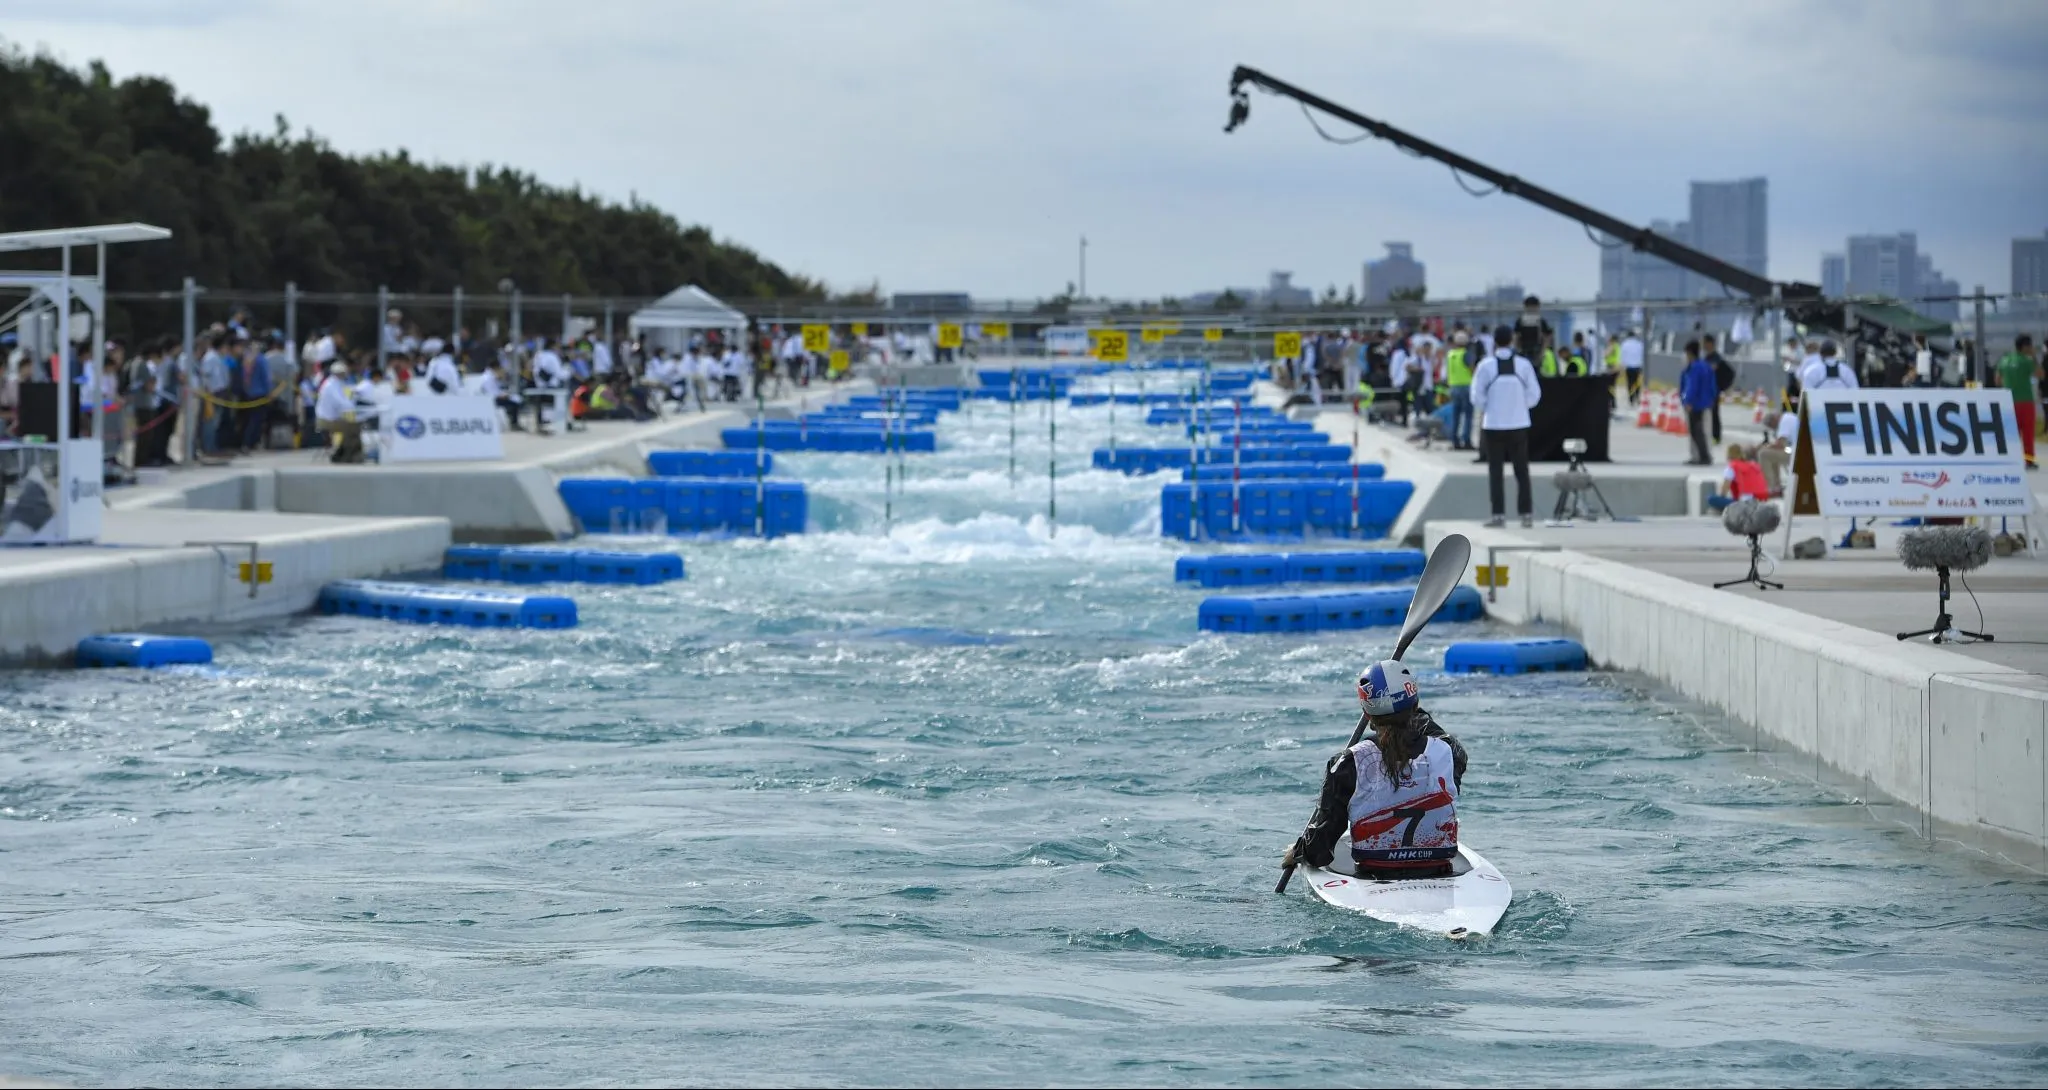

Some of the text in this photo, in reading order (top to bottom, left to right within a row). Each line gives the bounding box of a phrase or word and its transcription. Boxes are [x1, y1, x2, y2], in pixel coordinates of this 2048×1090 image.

[806, 329, 825, 347] 21
[1102, 336, 1124, 357] 22
[1279, 337, 1299, 354] 20
[429, 418, 493, 435] SUBARU
[1824, 401, 2008, 456] FINISH
[1851, 476, 1890, 485] SUBARU
[1393, 809, 1426, 847] 7
[1388, 850, 1433, 859] NHK CUP
